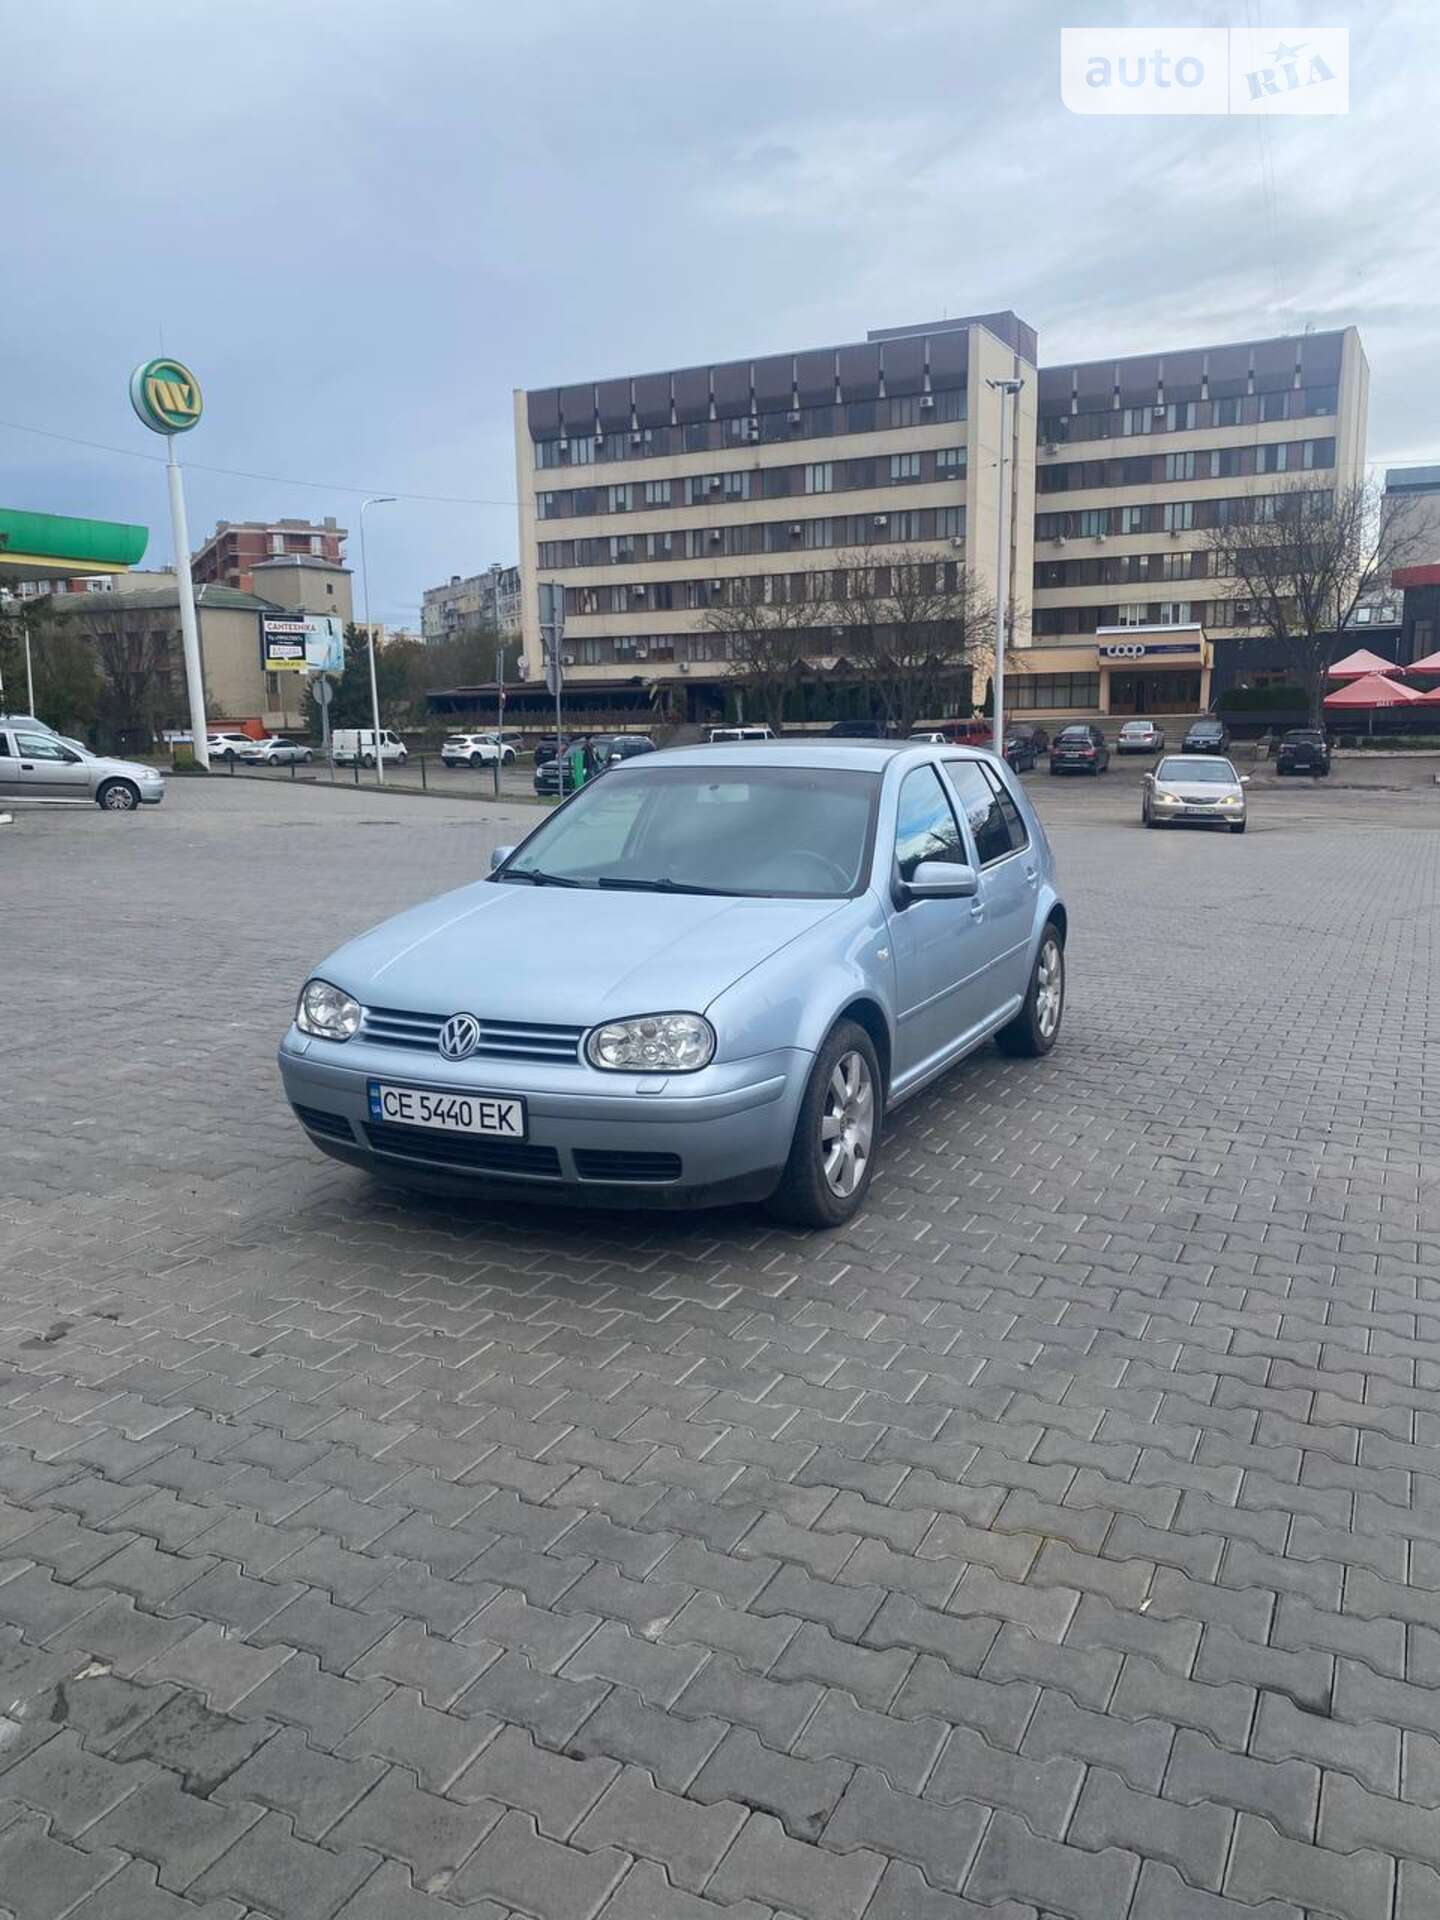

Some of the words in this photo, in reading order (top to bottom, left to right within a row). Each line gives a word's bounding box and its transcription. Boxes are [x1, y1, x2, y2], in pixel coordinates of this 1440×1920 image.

[383, 1091, 415, 1120] CE
[420, 1096, 472, 1127] 5440
[479, 1102, 516, 1131] EK
